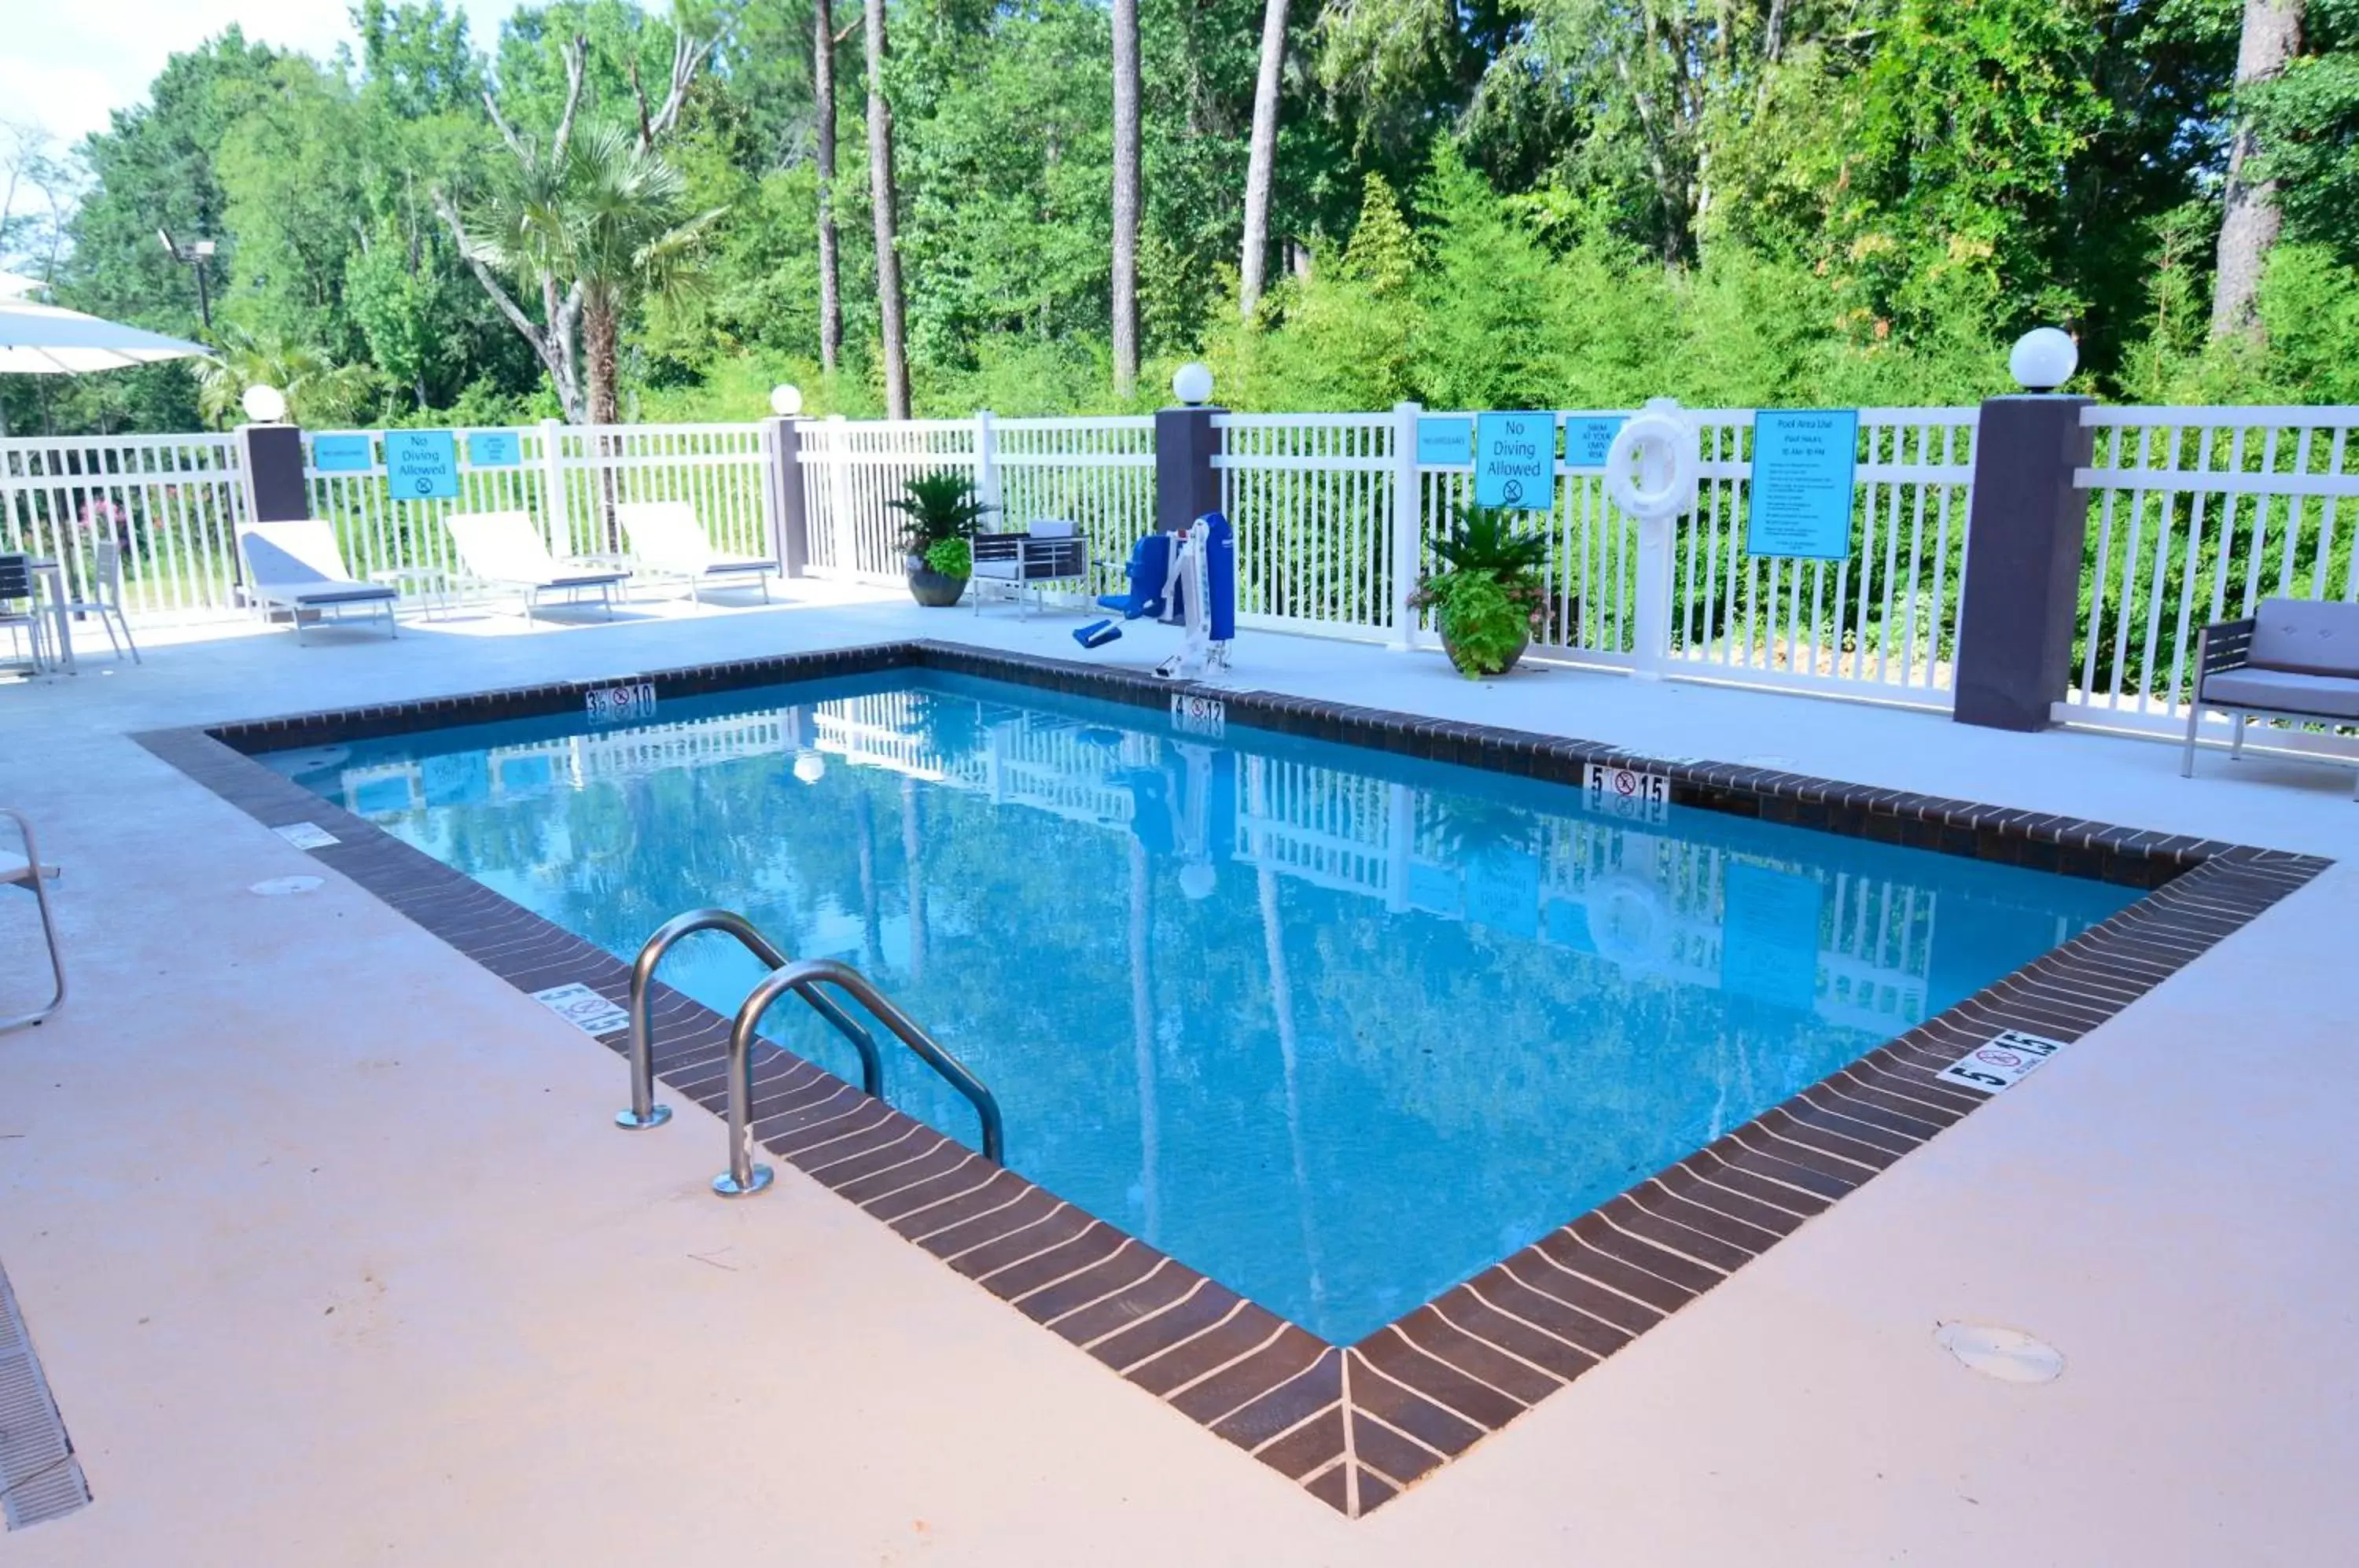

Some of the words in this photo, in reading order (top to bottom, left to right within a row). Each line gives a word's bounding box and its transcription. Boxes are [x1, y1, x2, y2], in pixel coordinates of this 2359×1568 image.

[1506, 421, 1525, 435] No
[410, 436, 429, 446] No
[402, 449, 440, 462] Diving
[1493, 440, 1536, 460] Diving
[399, 463, 446, 476] Allowed
[1487, 461, 1540, 477] Allowed
[1592, 767, 1603, 793] 5
[1949, 1067, 2008, 1086] 5
